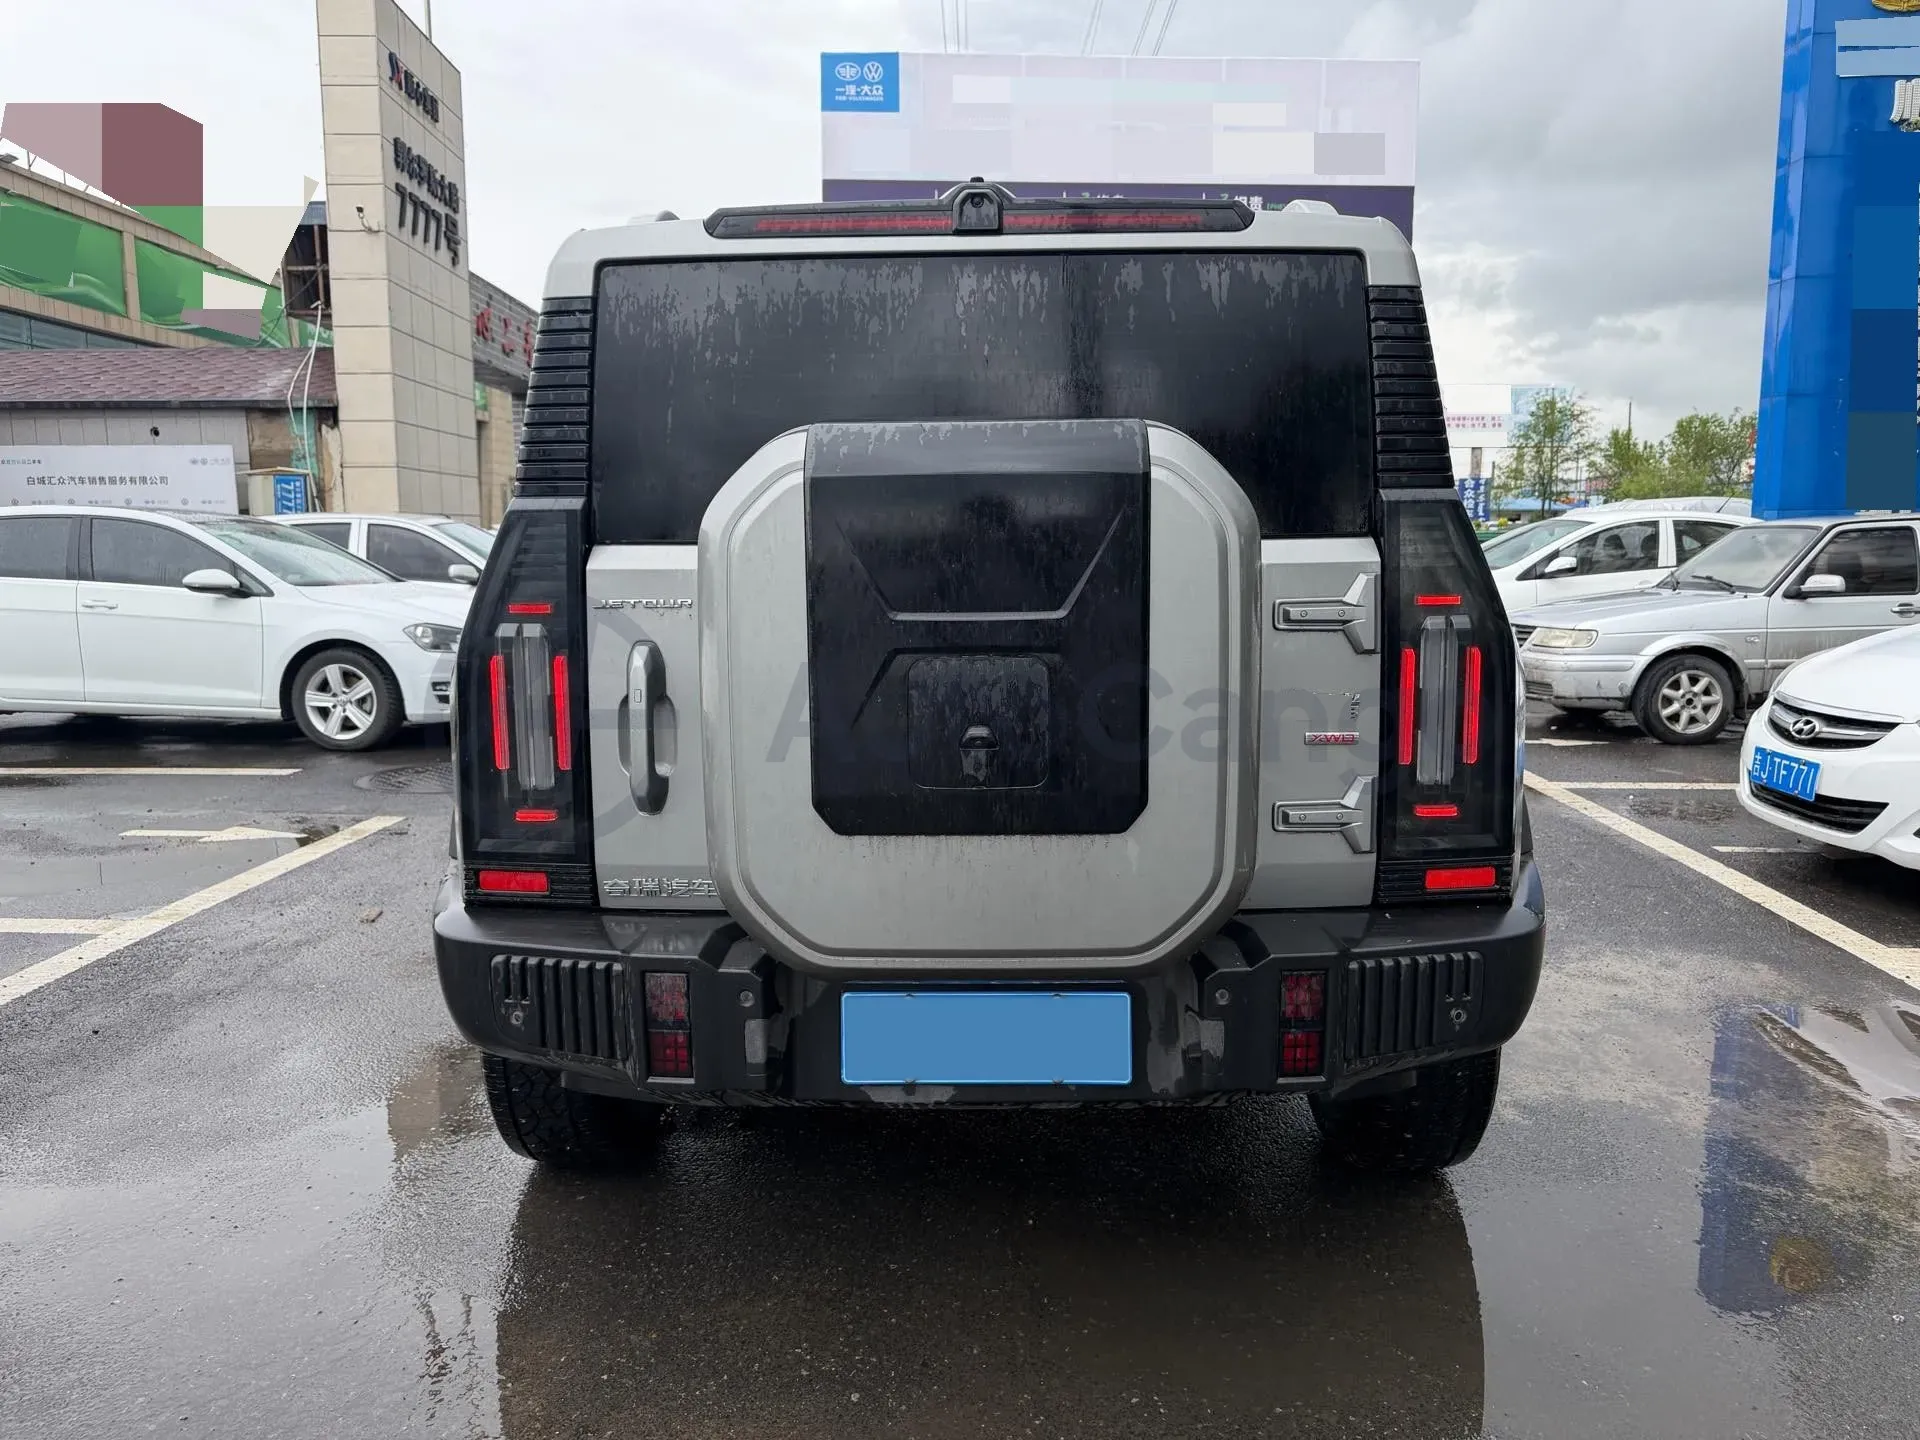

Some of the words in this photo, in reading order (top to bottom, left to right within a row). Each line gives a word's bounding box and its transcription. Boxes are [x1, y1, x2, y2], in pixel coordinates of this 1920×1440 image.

[395, 182, 461, 267] 7777号
[26, 475, 169, 487] 白城汇众汽车销售服务有限公司
[592, 598, 693, 609] JETOUR
[603, 878, 718, 897] 奇瑞汽车
